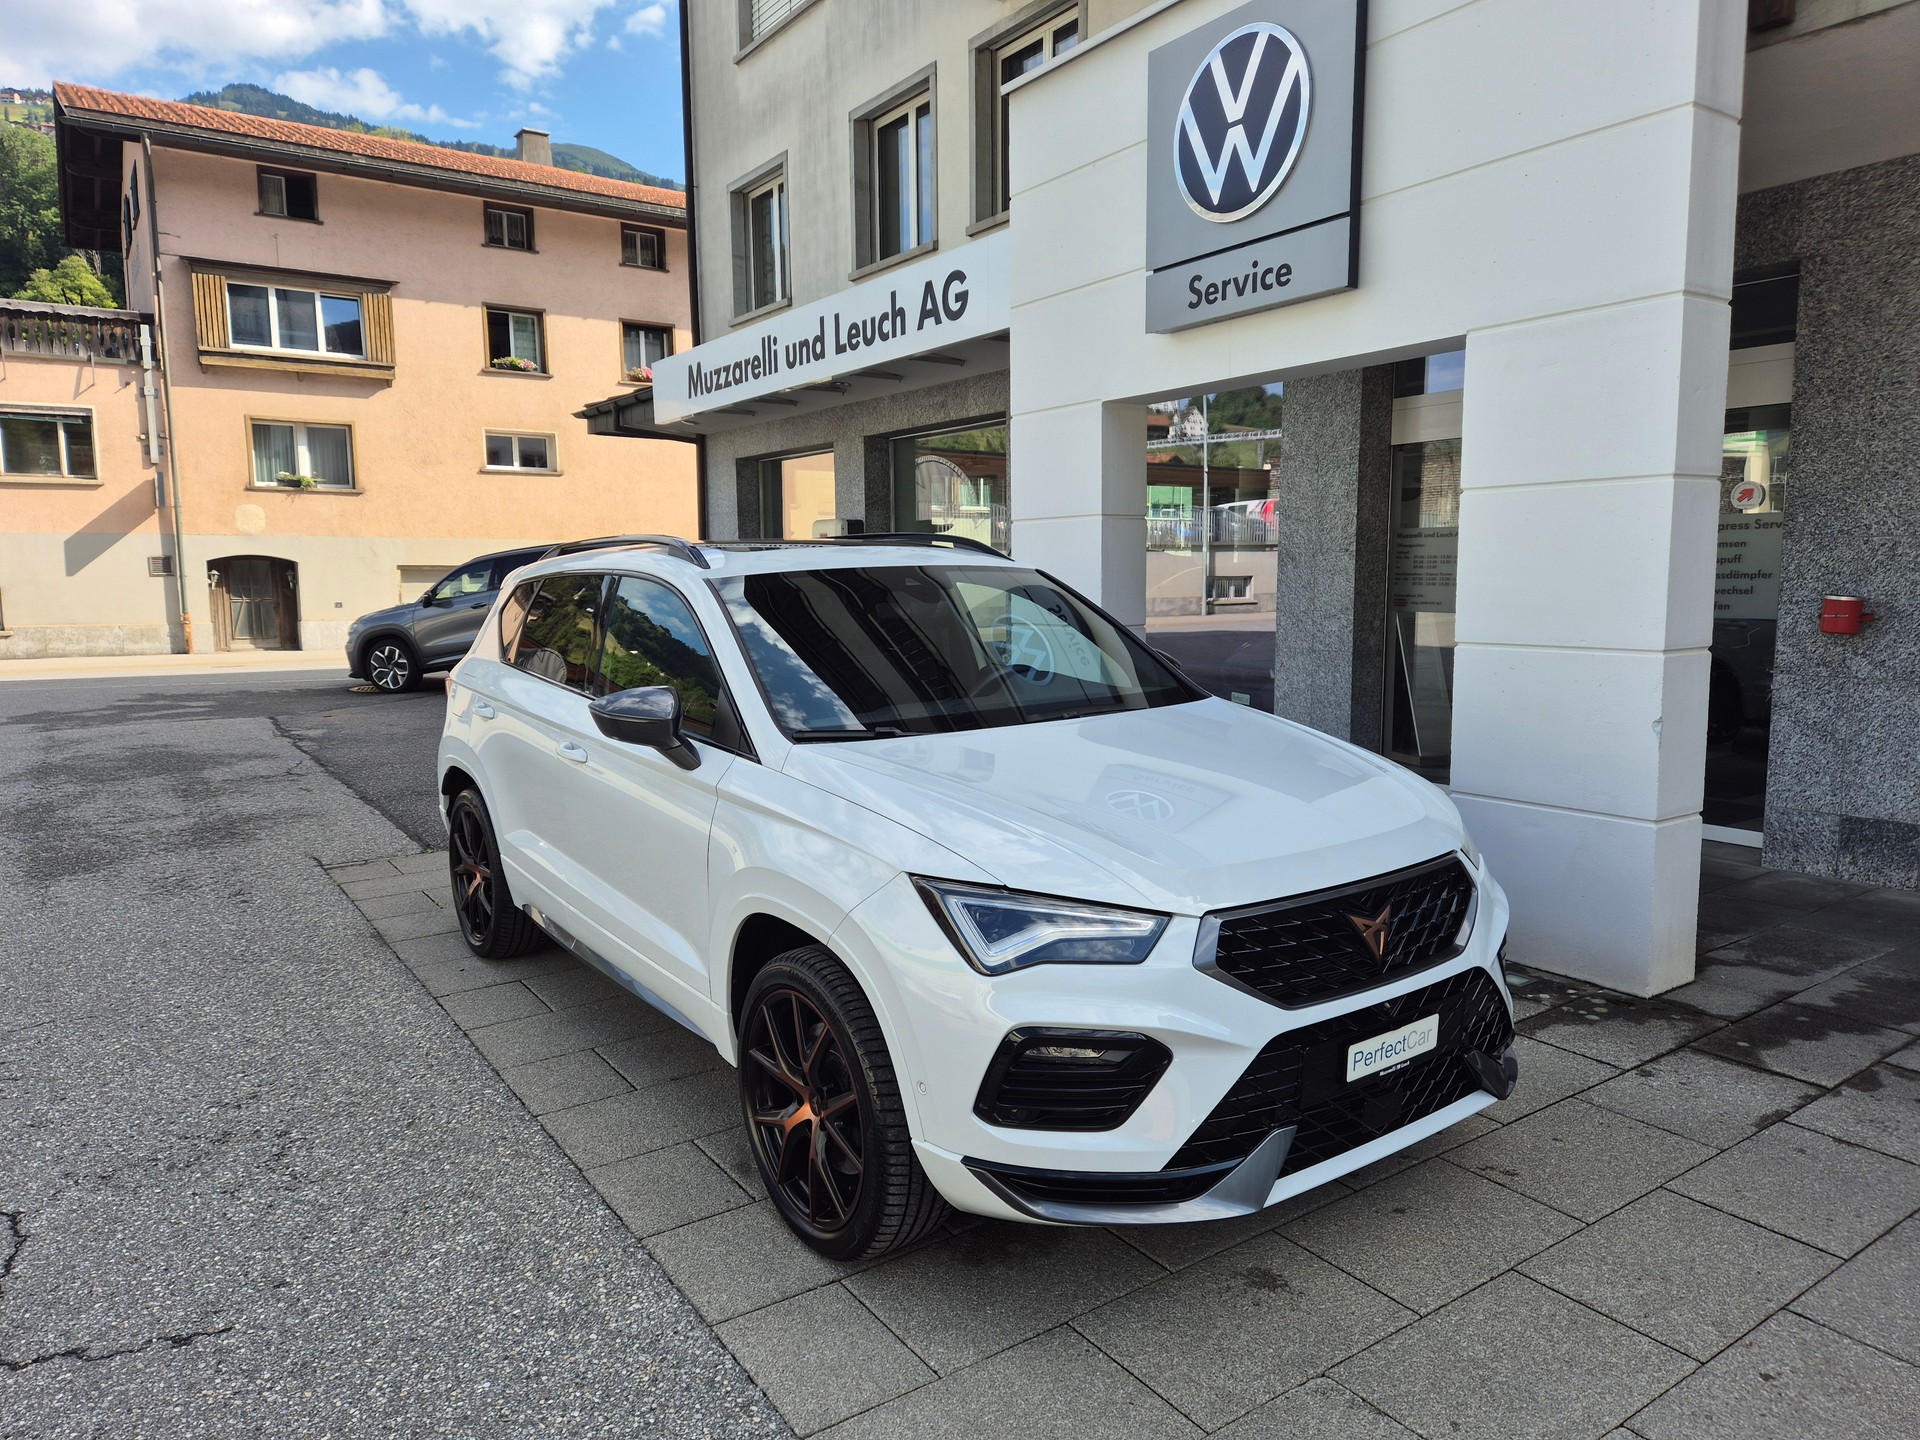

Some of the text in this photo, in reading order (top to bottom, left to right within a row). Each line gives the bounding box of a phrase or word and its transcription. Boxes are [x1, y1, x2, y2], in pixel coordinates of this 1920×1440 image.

[1176, 27, 1306, 214] VW
[1187, 260, 1293, 310] Service
[688, 269, 969, 399] Muzzarelli und Leuch AG
[1718, 518, 1783, 534] press Serv
[1716, 553, 1742, 565] puff
[1716, 569, 1772, 580] ssdämpfer
[1714, 600, 1730, 610] fen
[1353, 1027, 1433, 1071] PerfectCar
